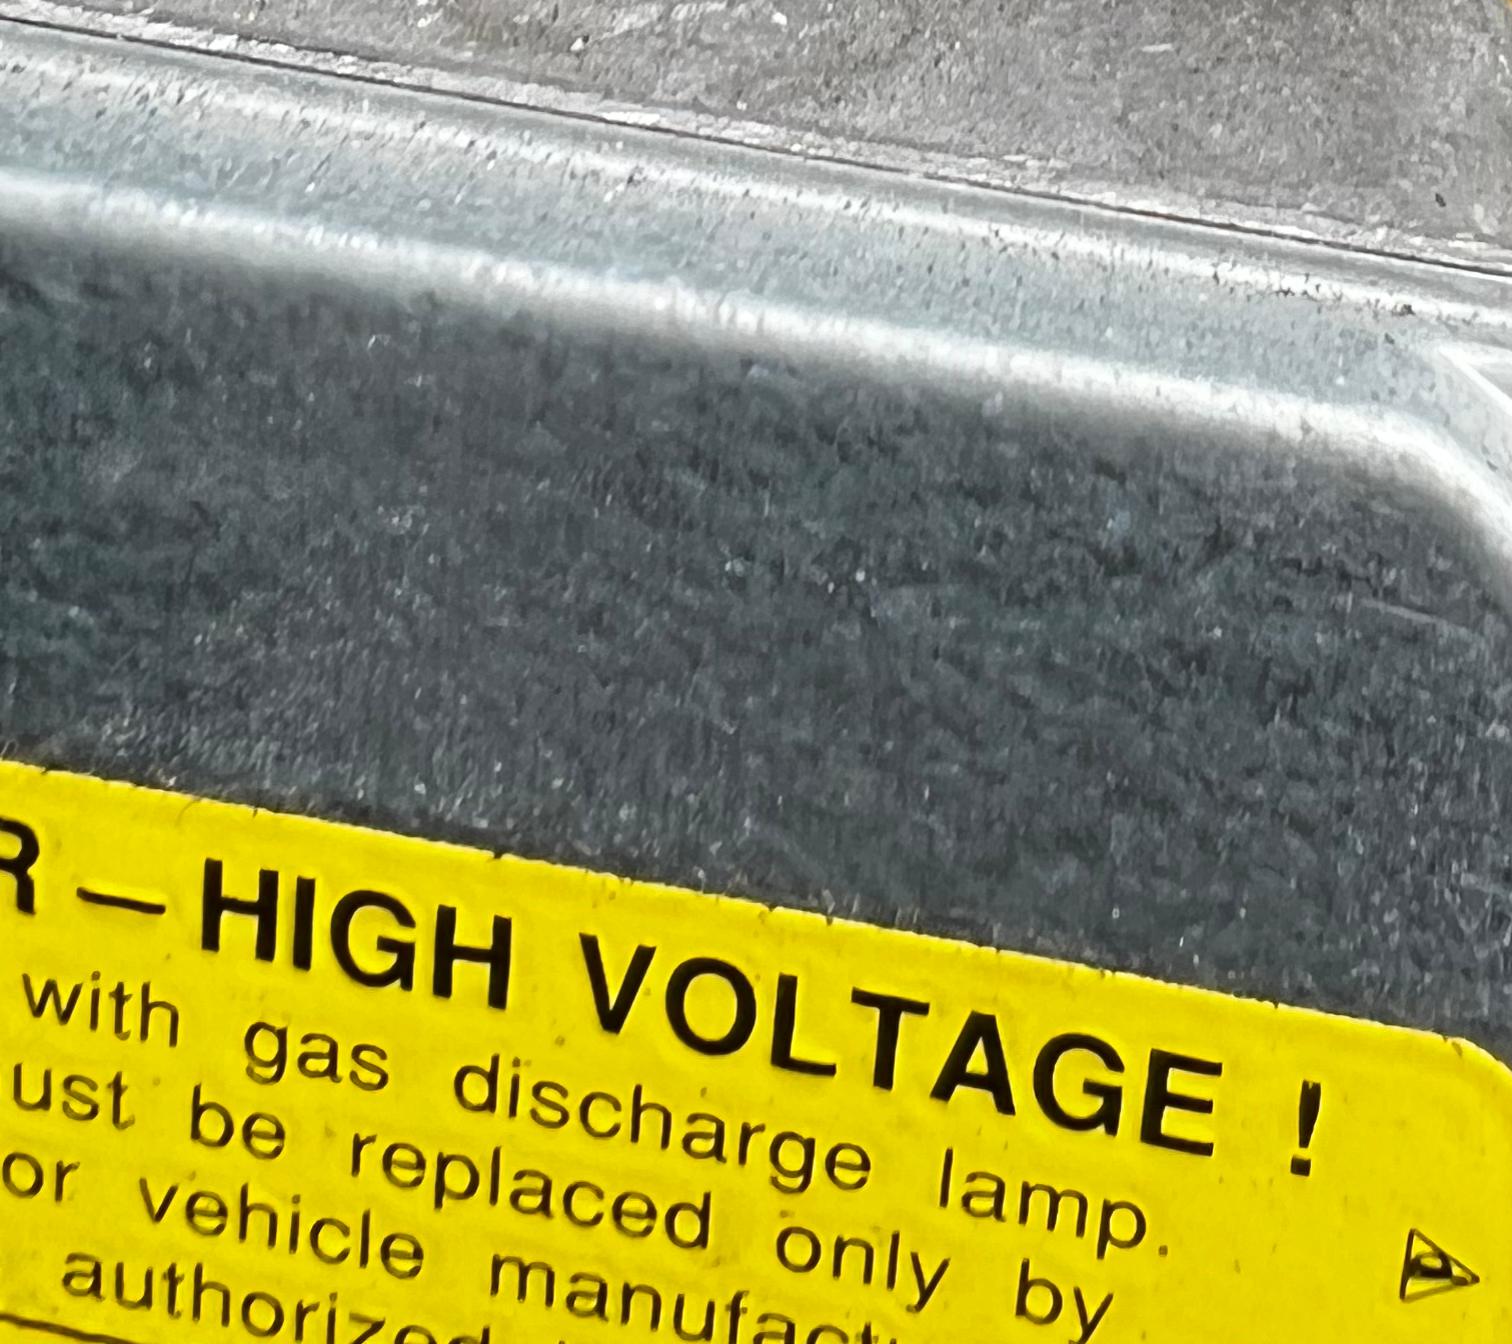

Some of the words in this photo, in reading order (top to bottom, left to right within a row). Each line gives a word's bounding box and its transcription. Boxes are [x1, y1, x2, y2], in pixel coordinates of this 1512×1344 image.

[22, 971, 180, 1048] with
[244, 1021, 390, 1091] gas
[453, 1053, 872, 1194] discharge
[940, 1148, 1169, 1260] lamp.
[201, 857, 513, 1010] HIGH
[579, 932, 1223, 1157] VOLTAGE
[2, 1151, 80, 1203] or
[140, 1177, 425, 1280] vehicle
[12, 1062, 136, 1129] ust
[191, 1084, 286, 1161] be
[352, 1130, 712, 1251] replaced
[776, 1226, 950, 1312] only
[1015, 1258, 1114, 1344] by
